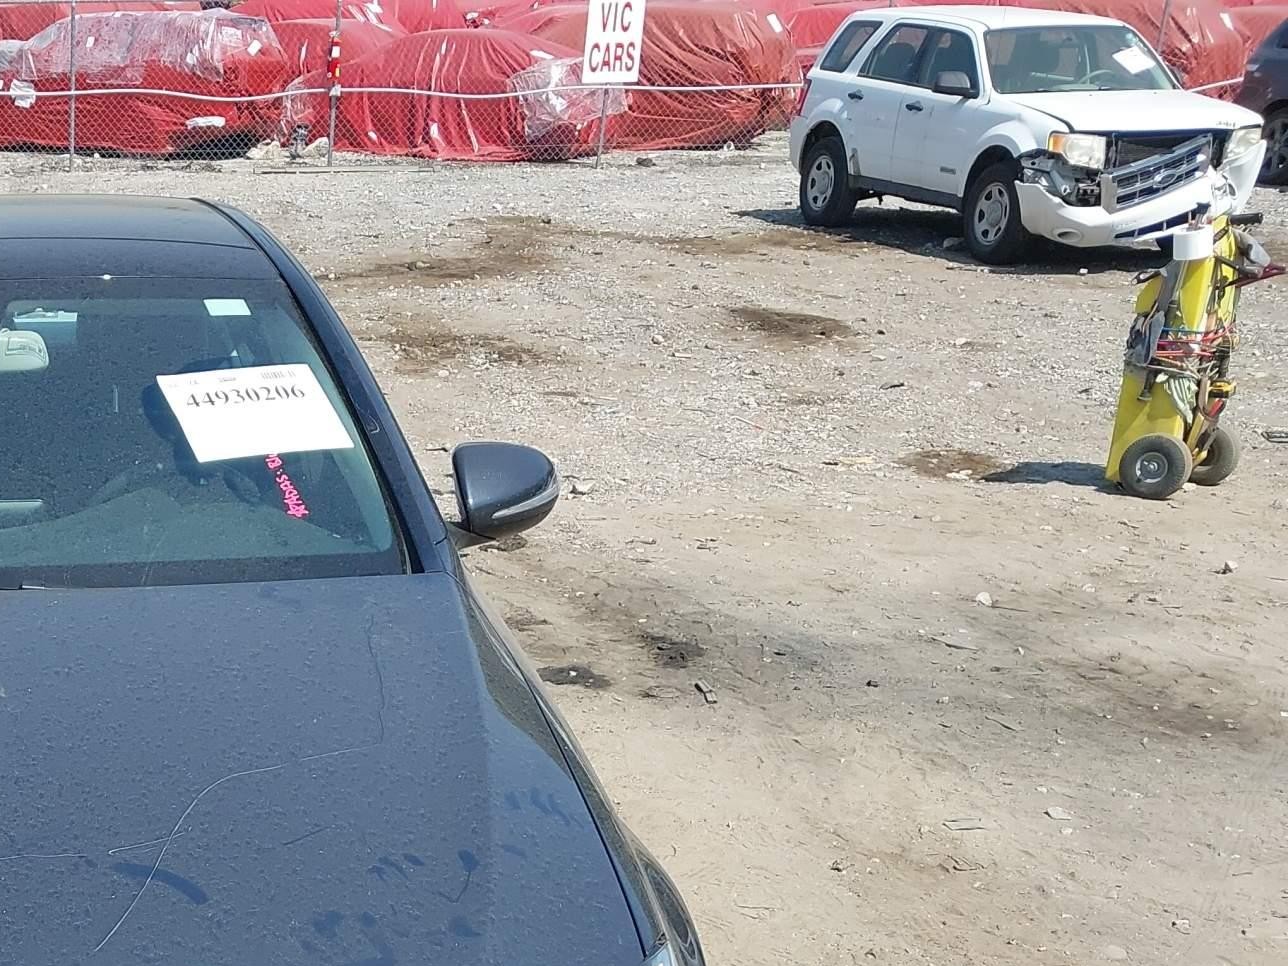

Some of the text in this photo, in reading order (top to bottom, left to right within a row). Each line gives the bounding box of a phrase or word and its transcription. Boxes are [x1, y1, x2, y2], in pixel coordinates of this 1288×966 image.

[601, 2, 633, 33] VIC
[589, 41, 635, 72] CARS
[186, 383, 306, 408] 44930206
